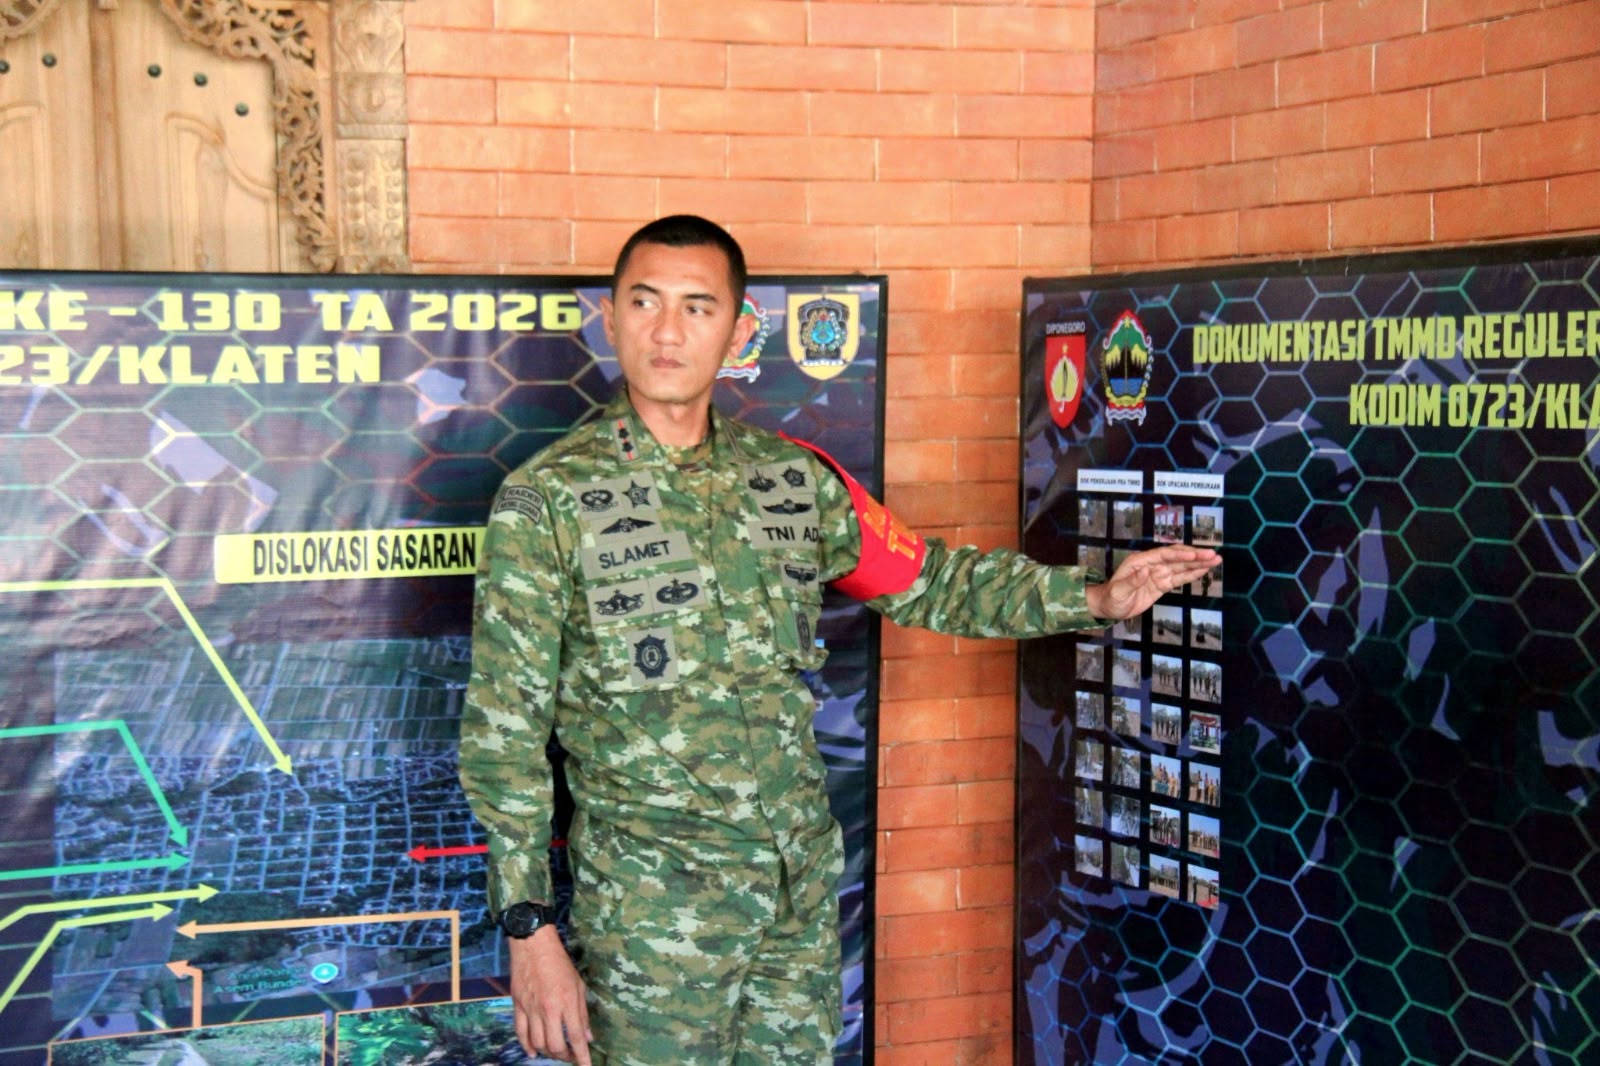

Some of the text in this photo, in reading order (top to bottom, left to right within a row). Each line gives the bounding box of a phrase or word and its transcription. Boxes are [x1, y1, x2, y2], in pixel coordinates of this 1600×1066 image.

[0, 291, 88, 330] KE
[158, 292, 281, 331] 130
[313, 293, 393, 331] TA
[409, 294, 582, 331] 2026
[1193, 310, 1600, 364] DOKUMENTASI TMMD REGULER
[1350, 384, 1441, 426] KODIM
[253, 532, 476, 576] DISLOKASI SASARAN
[598, 540, 670, 569] SLAMET
[762, 526, 820, 542] TNI AD
